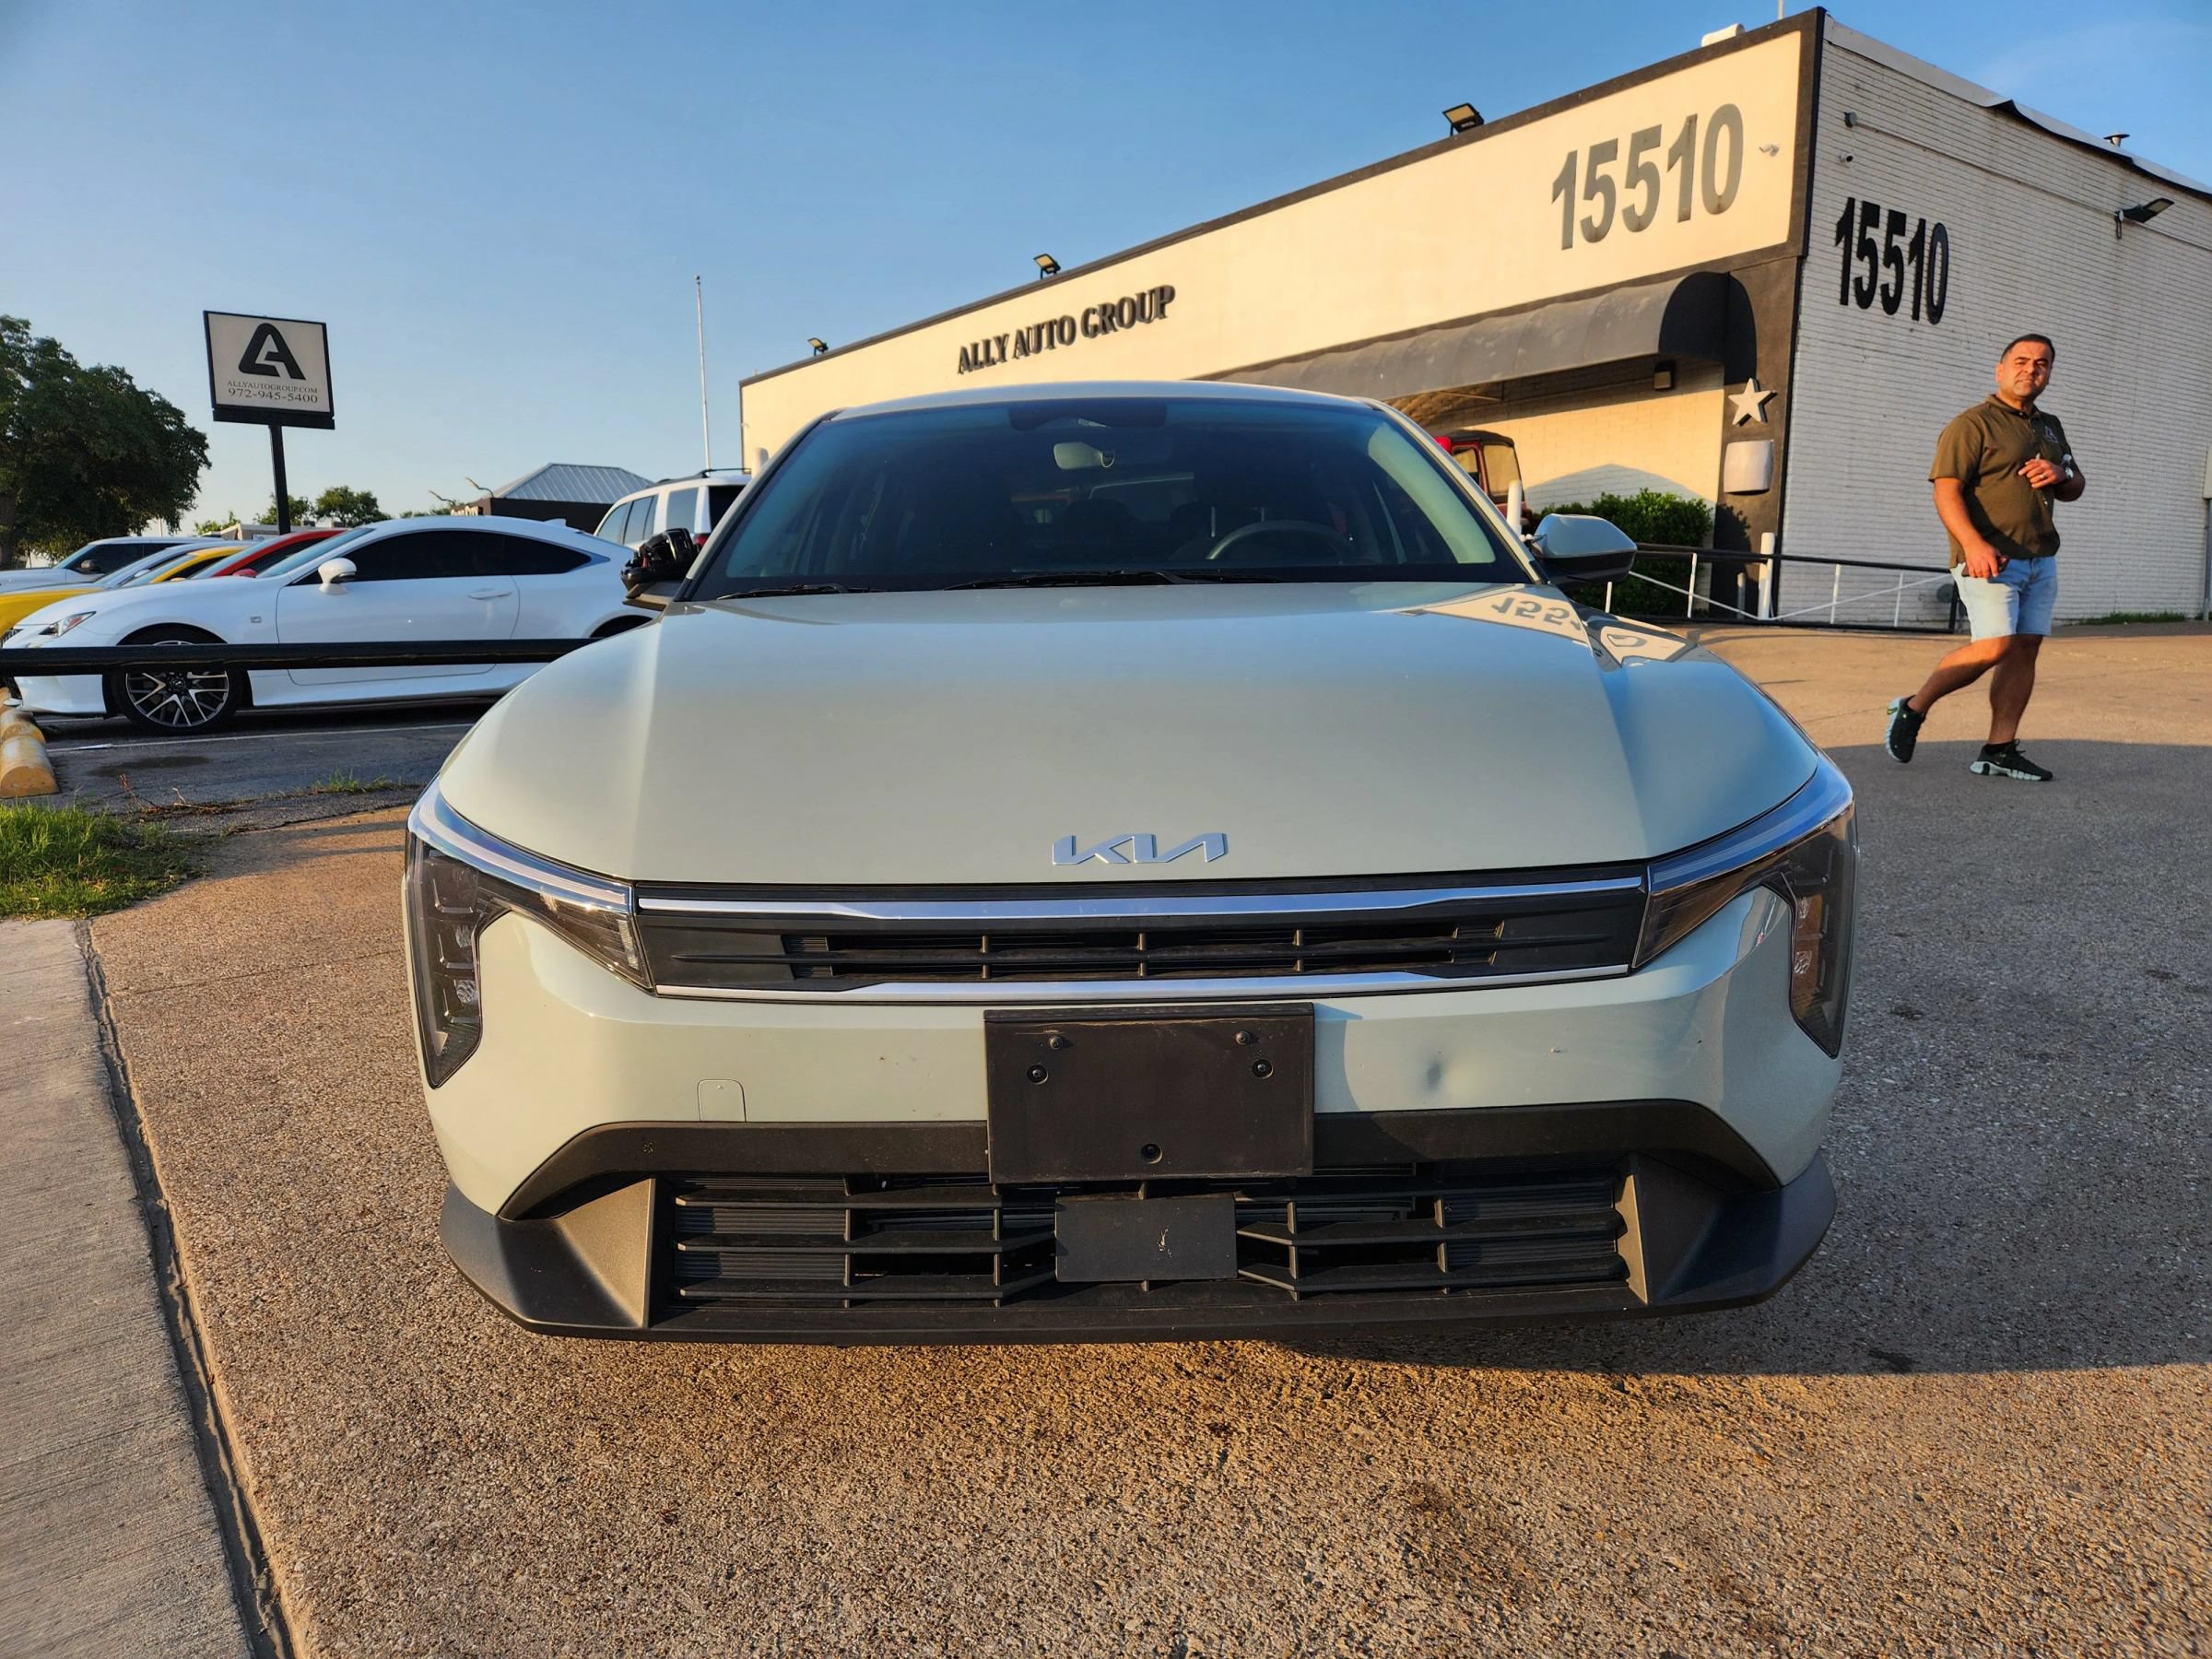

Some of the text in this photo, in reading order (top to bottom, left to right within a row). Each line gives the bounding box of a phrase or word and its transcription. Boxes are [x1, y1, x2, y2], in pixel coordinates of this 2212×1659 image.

[1551, 103, 1744, 251] 15510
[1835, 197, 1949, 324] 15510
[958, 285, 1176, 374] ALLY AUTO GROUP
[228, 381, 318, 394] ALLYAUTOGROUP.COM
[229, 388, 318, 403] 972-945-5400
[1053, 832, 1228, 865] KIA
